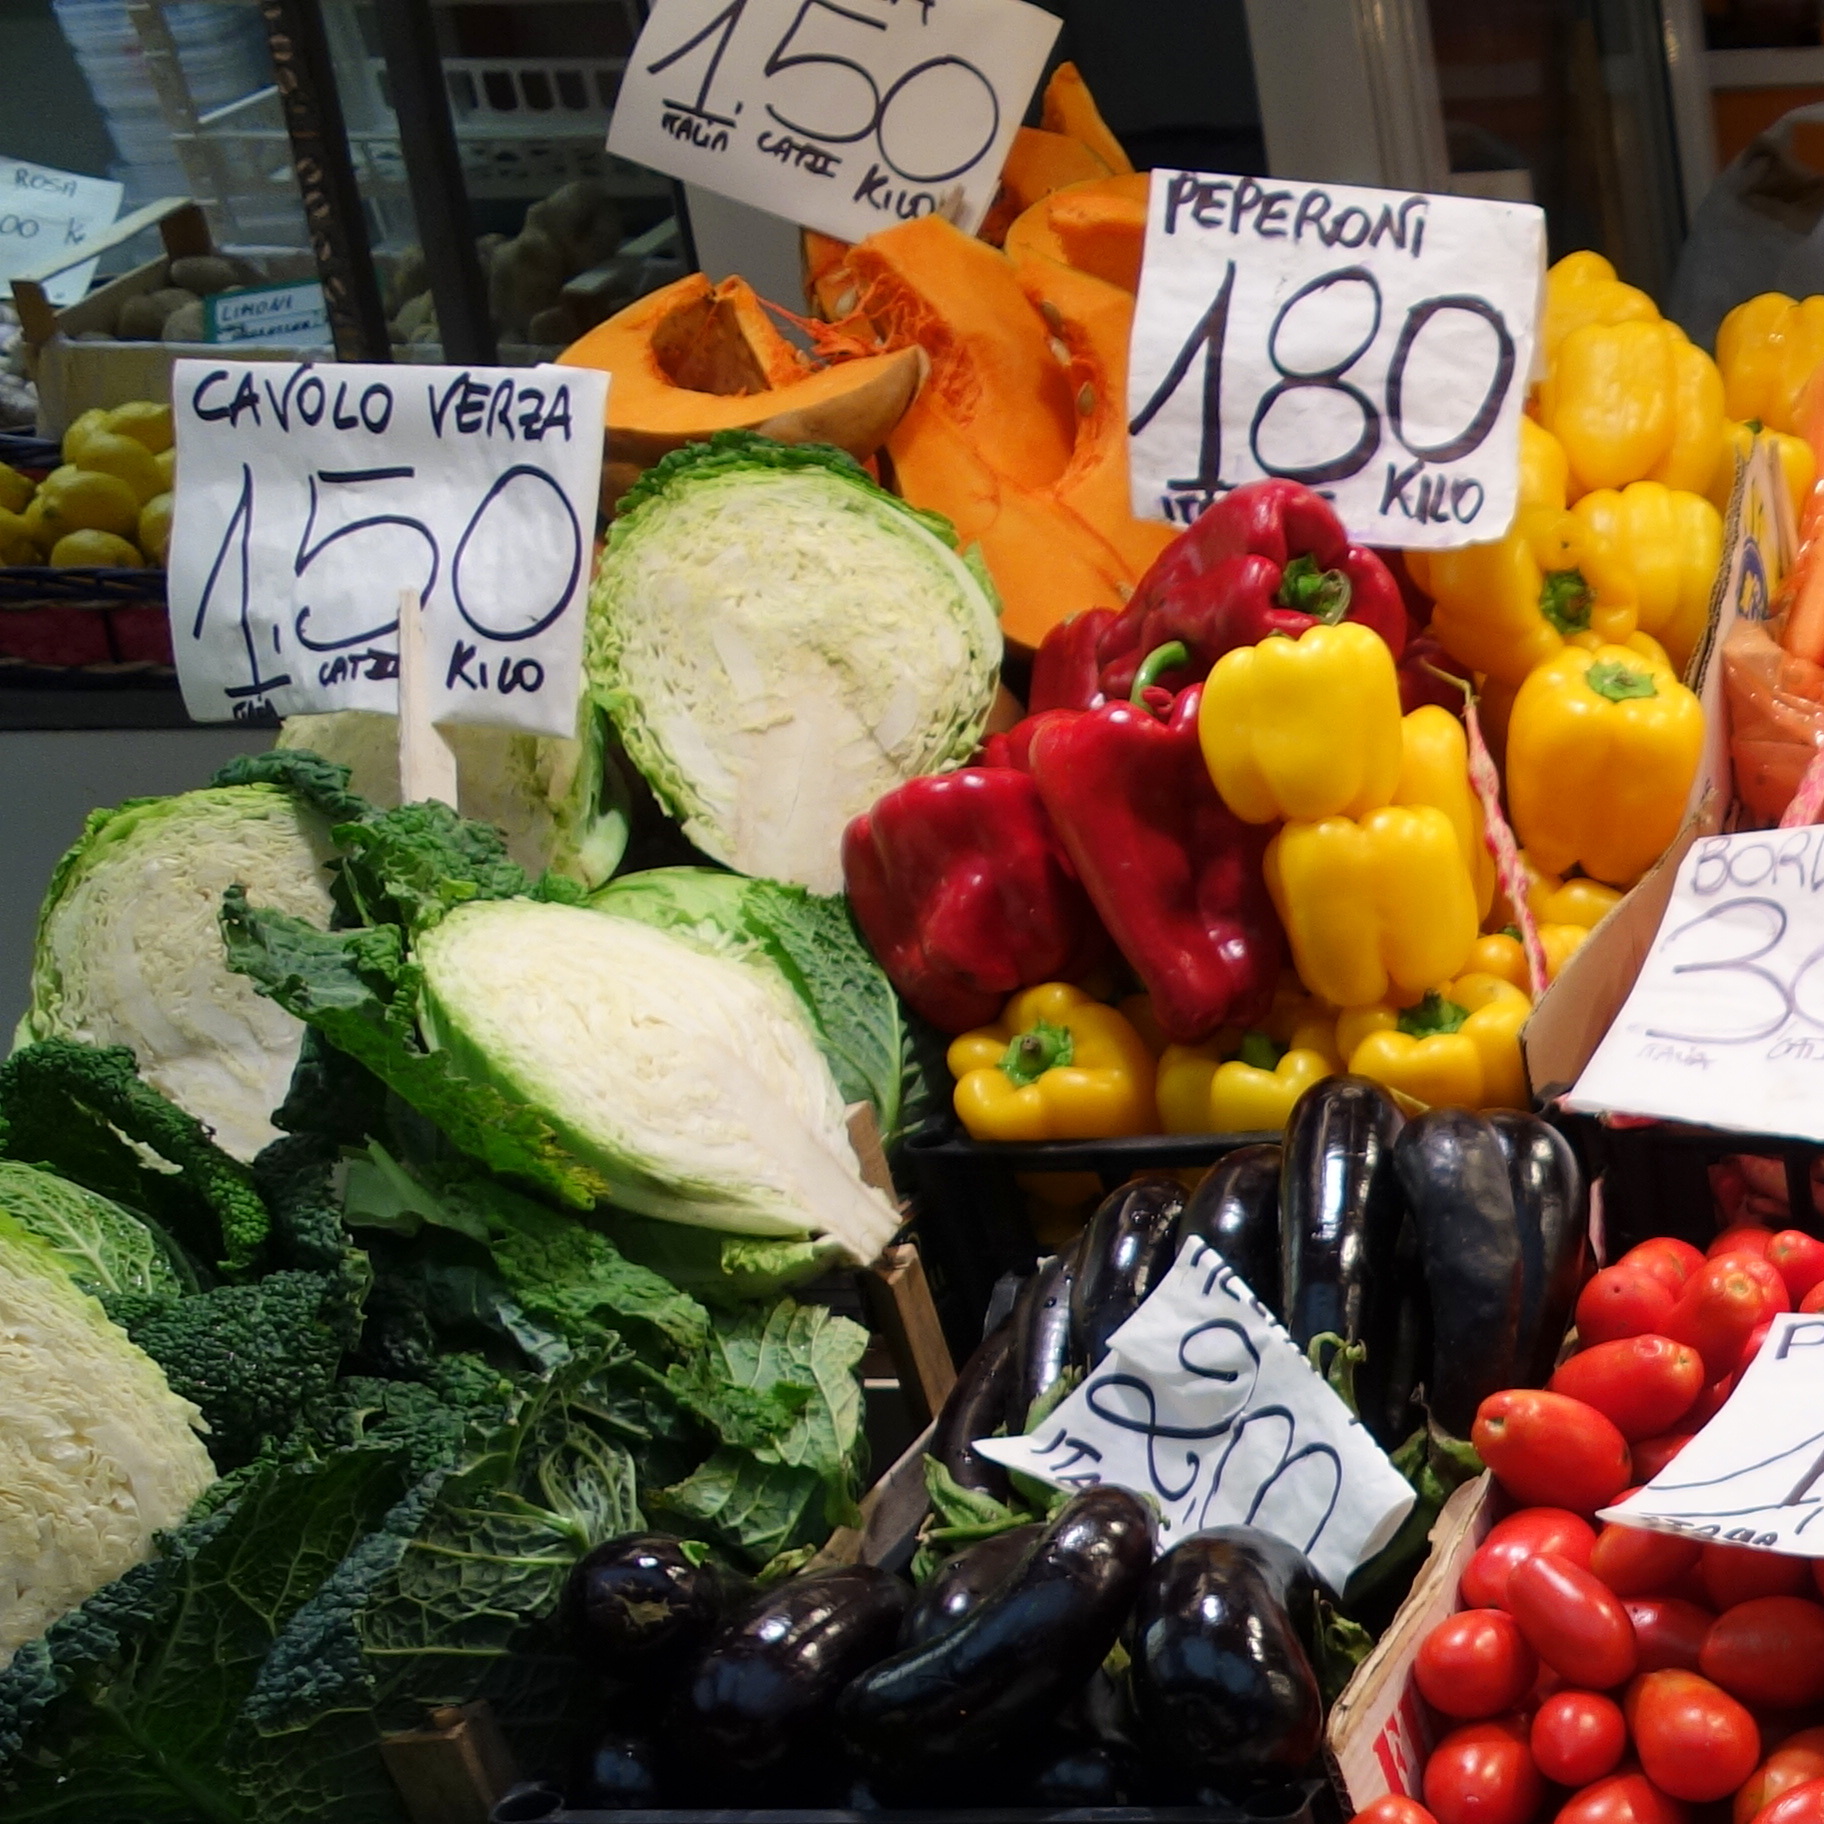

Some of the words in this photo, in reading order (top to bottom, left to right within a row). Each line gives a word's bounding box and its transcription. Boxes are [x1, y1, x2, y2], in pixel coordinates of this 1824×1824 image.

[1164, 171, 1432, 259] PEPERONI
[193, 362, 394, 434] CAVOLO
[428, 371, 574, 442] VERZA
[1128, 260, 1517, 491] 180
[1379, 456, 1485, 526] KILO
[445, 639, 545, 694] KILO
